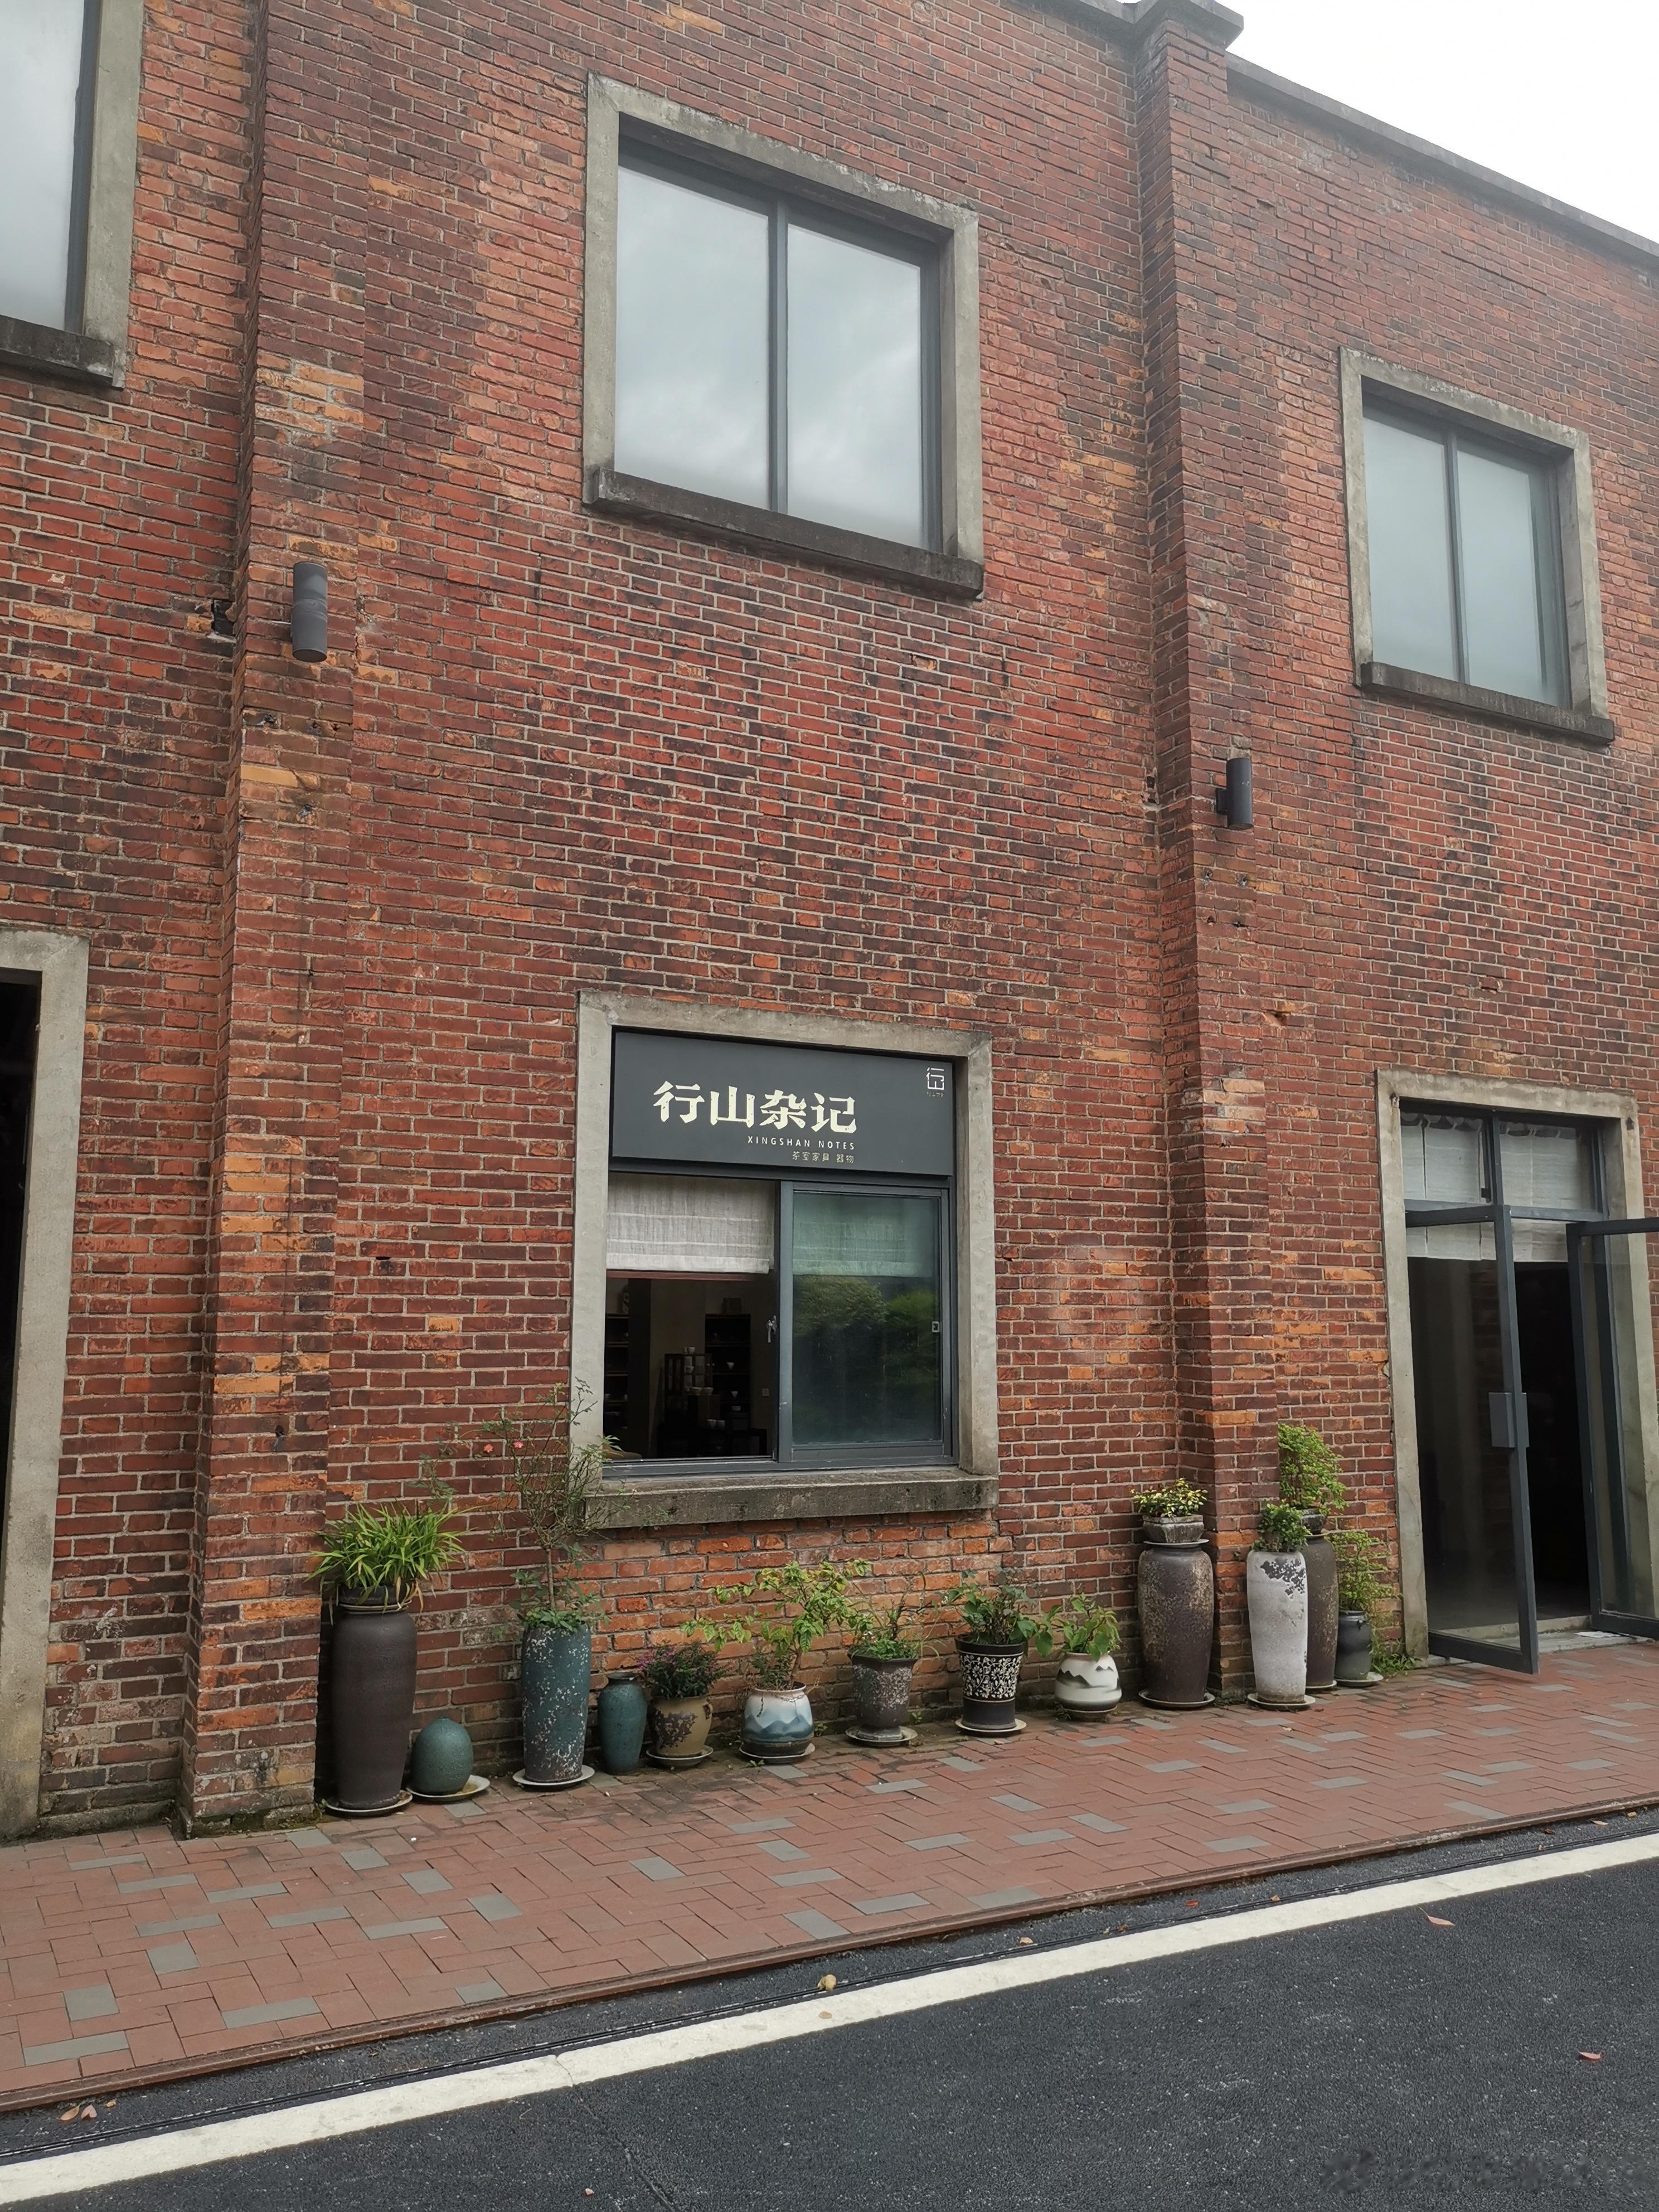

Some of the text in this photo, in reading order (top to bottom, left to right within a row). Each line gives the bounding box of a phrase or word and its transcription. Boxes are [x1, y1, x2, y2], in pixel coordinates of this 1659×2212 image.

[653, 1080, 857, 1133] 行山杂记
[748, 1136, 855, 1150] XINGSHAN NOTES
